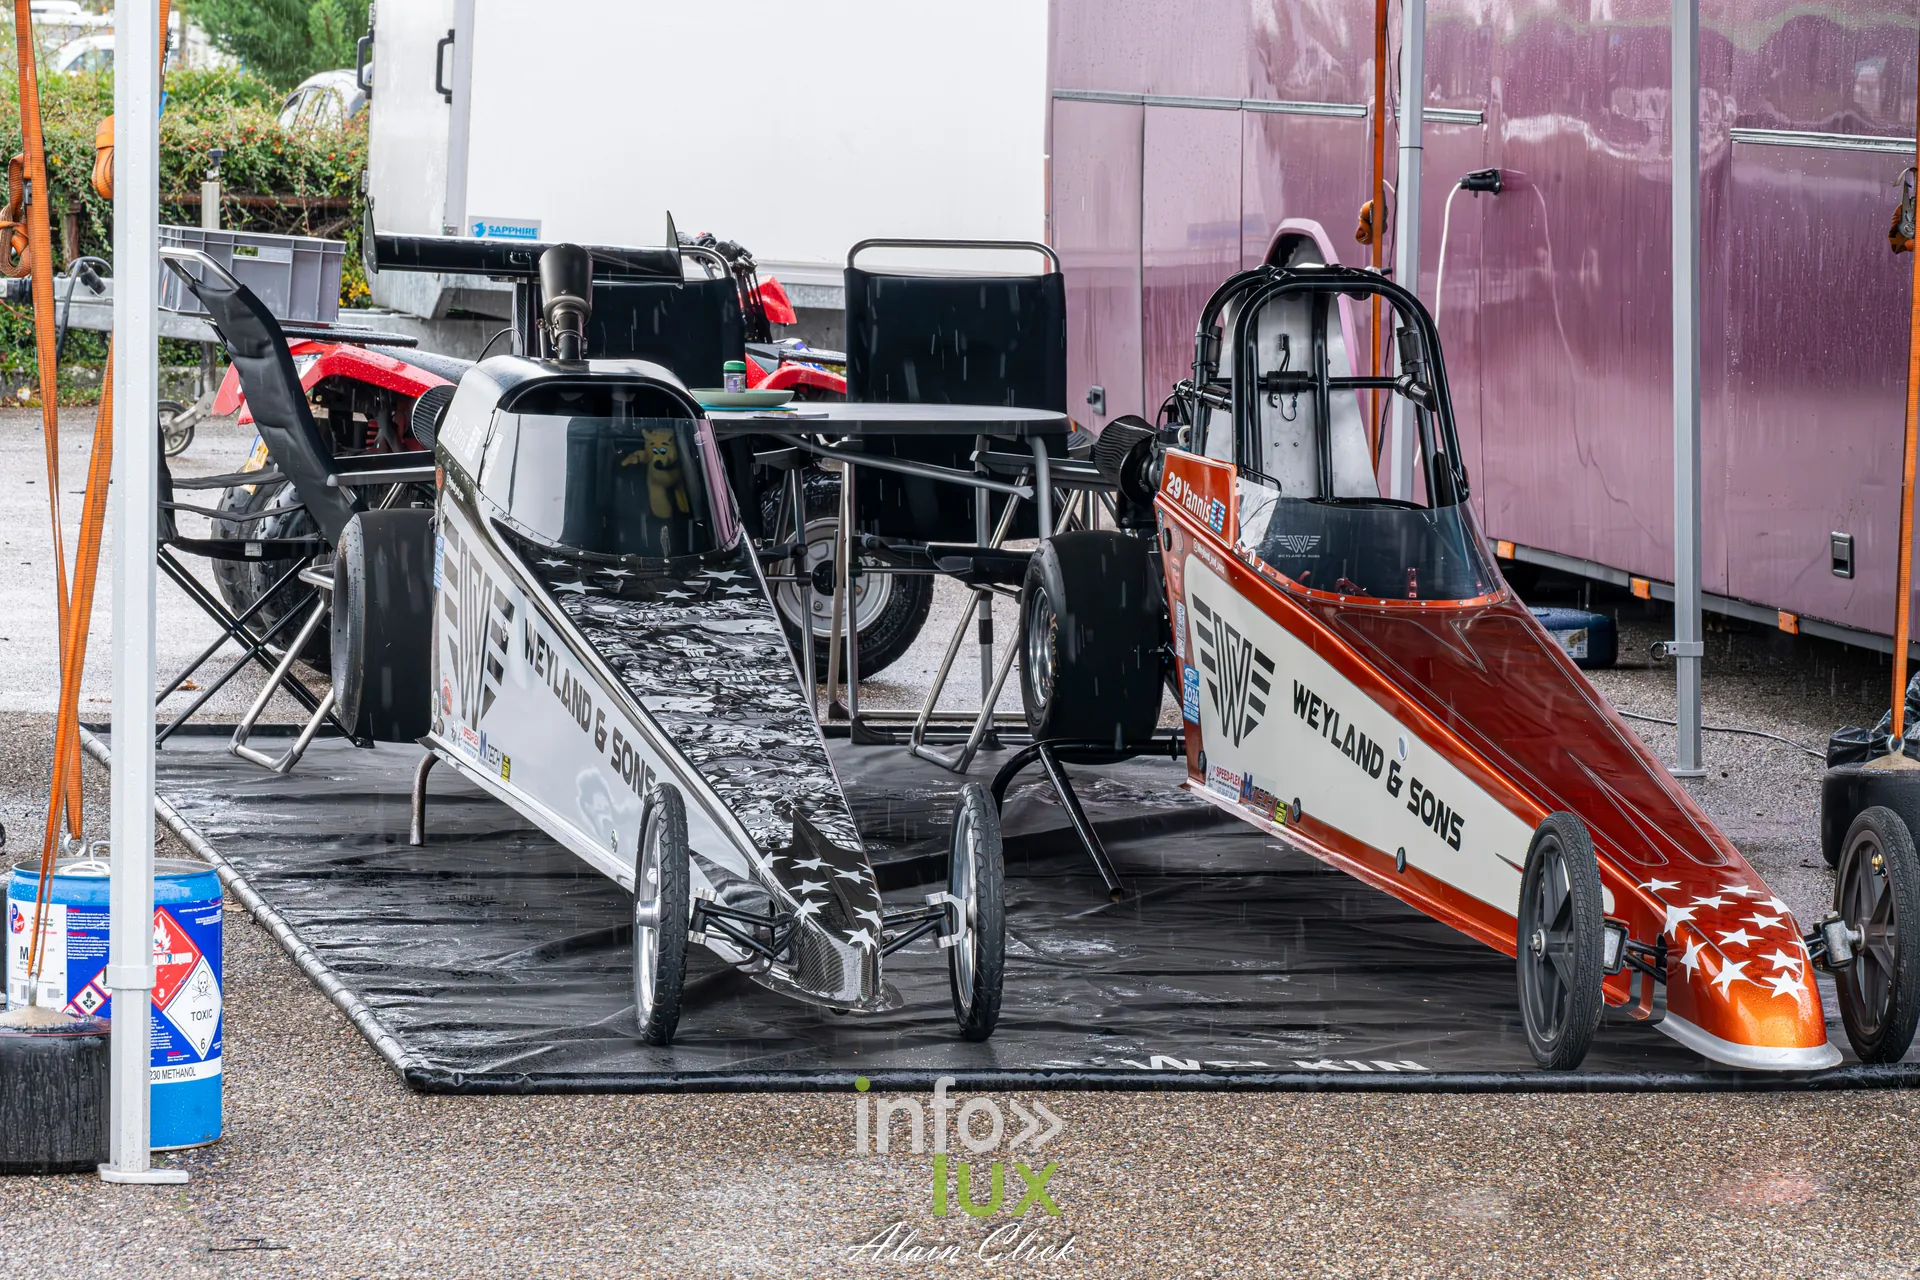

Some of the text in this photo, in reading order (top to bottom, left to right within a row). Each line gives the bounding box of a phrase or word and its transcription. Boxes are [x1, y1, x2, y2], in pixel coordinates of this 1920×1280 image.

[488, 225, 538, 236] SAPPHIRE
[1166, 471, 1211, 523] 29 Yannis
[524, 617, 592, 733] WEYLAND
[594, 707, 608, 754] &
[1293, 678, 1465, 851] WEYLAND & SONS
[158, 988, 165, 998] 3
[191, 1008, 213, 1022] TOXIC
[200, 1038, 206, 1050] 6
[161, 1066, 197, 1080] METHANOL
